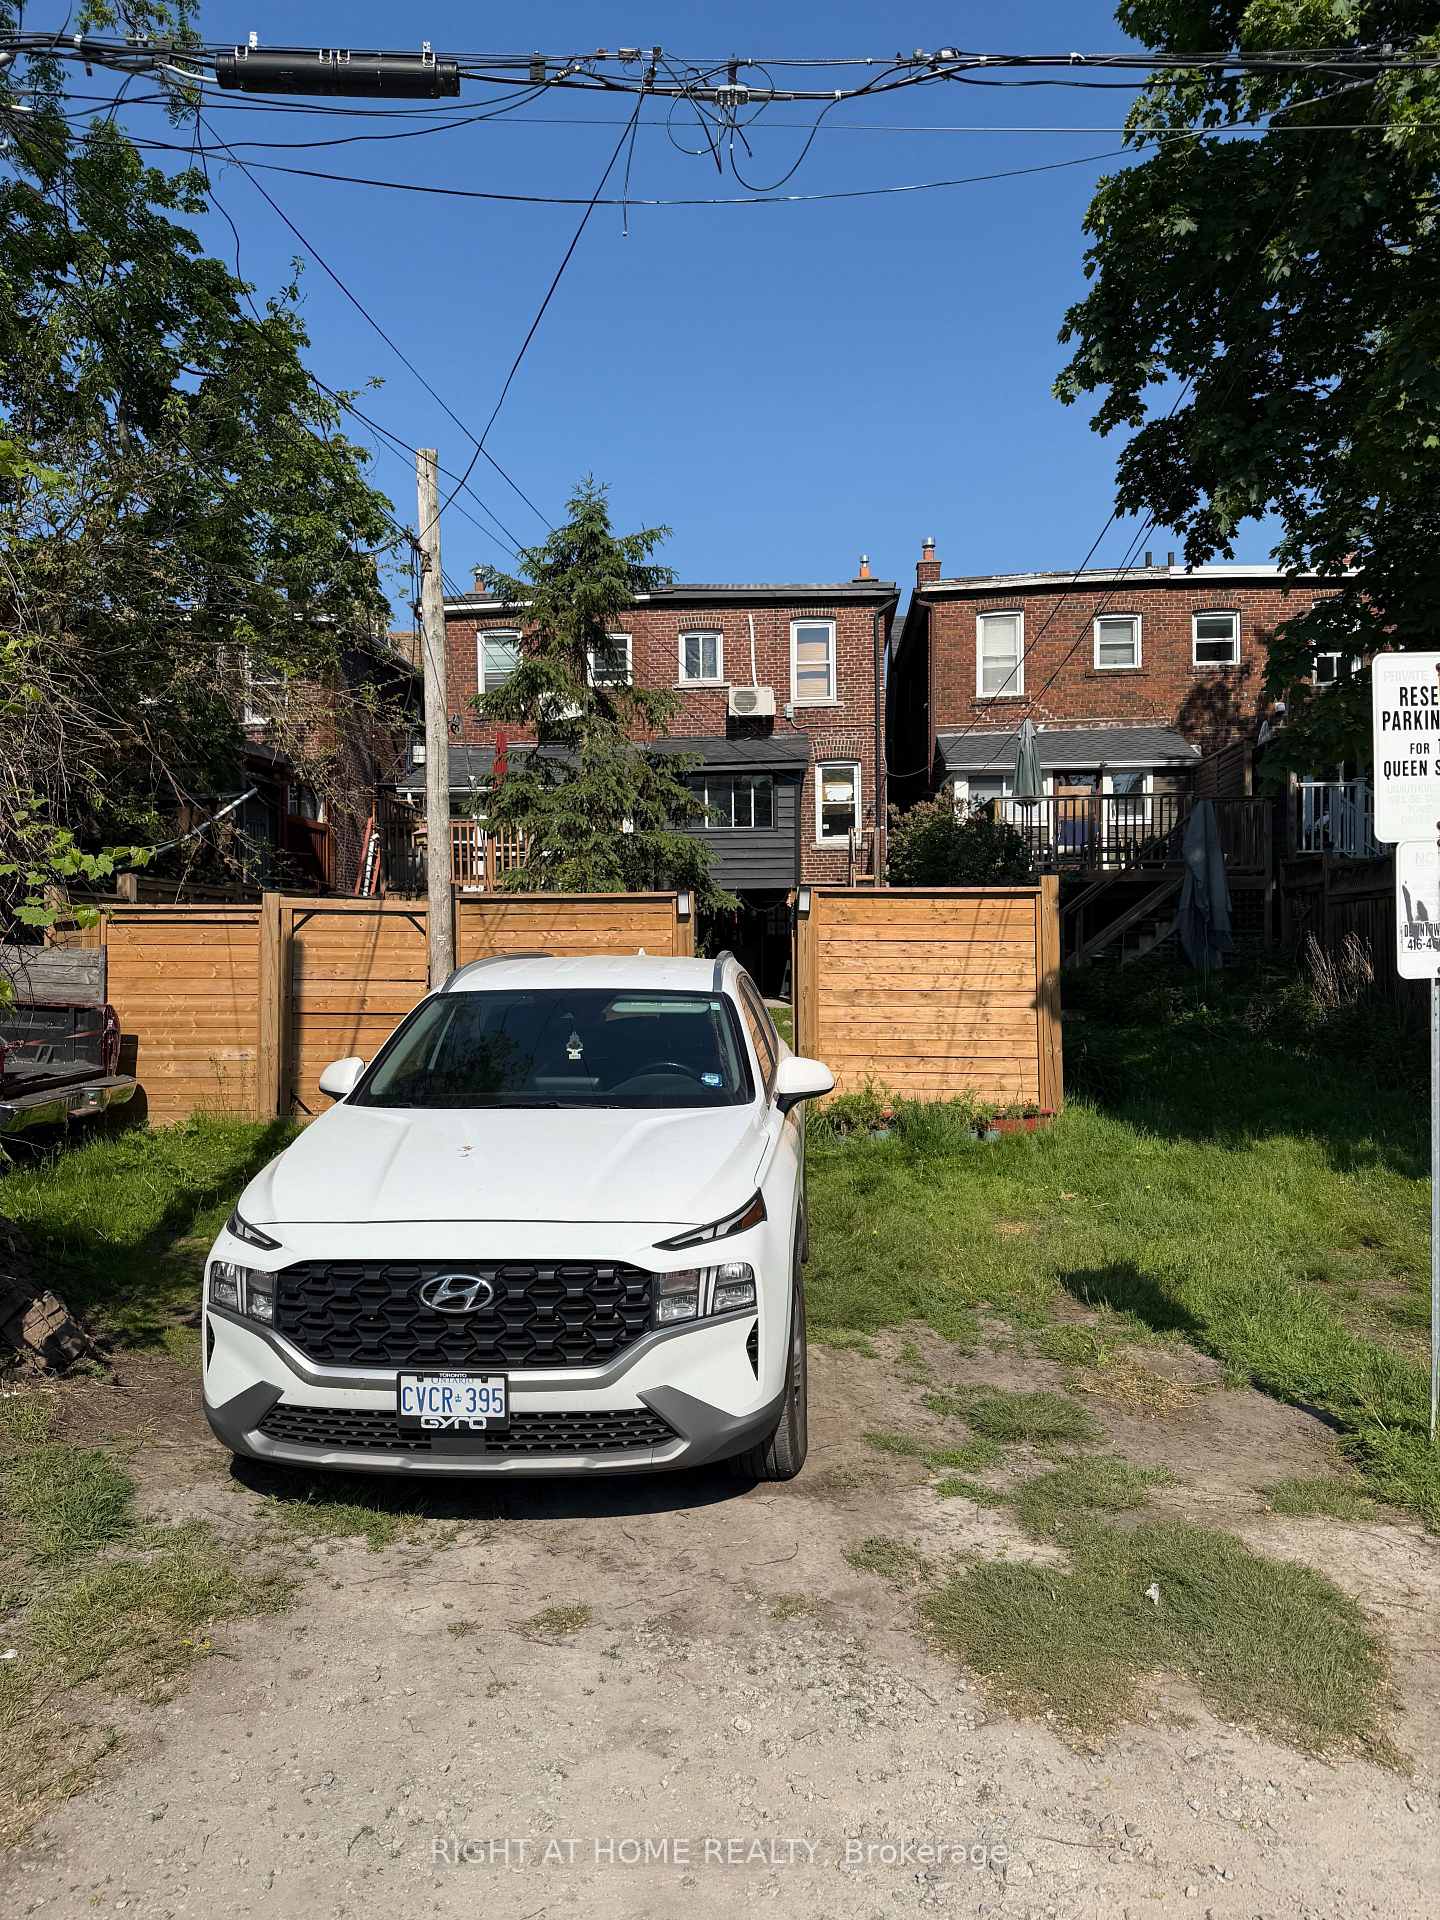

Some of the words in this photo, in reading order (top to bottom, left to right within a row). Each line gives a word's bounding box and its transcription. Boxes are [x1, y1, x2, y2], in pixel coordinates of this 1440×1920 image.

[1399, 685, 1438, 707] RESE
[1382, 710, 1440, 731] PARKIN
[1410, 742, 1430, 755] FOR
[1383, 760, 1427, 780] QUEEN
[431, 1377, 474, 1385] ONTARIO
[402, 1386, 453, 1413] CVCR
[465, 1387, 503, 1413] 395
